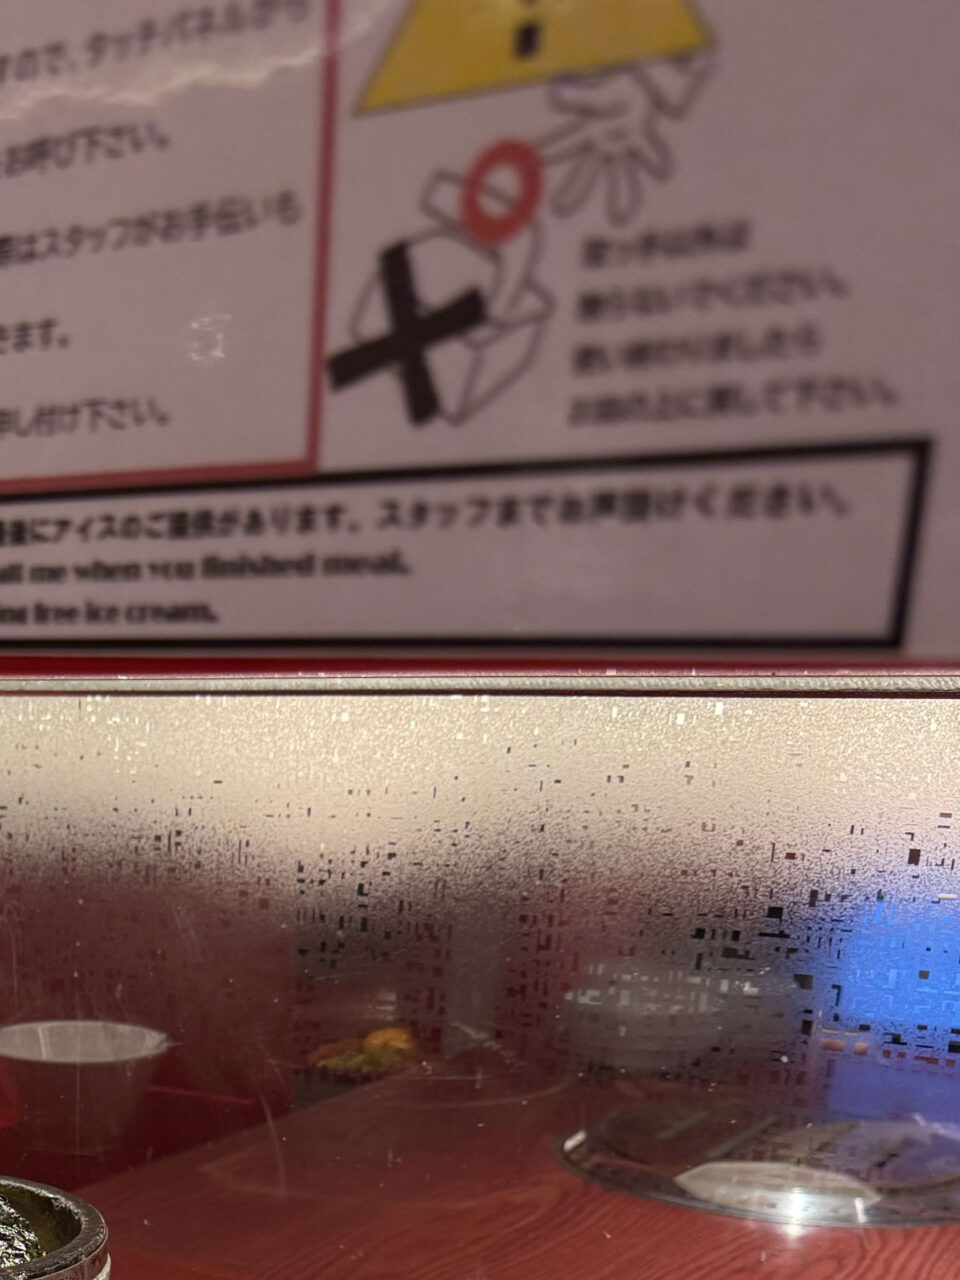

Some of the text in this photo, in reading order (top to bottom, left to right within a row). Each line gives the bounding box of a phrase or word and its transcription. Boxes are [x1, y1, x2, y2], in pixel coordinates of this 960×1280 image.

[30, 565, 67, 583] me
[73, 560, 142, 582] when
[34, 601, 80, 624] free
[85, 600, 120, 624] ice
